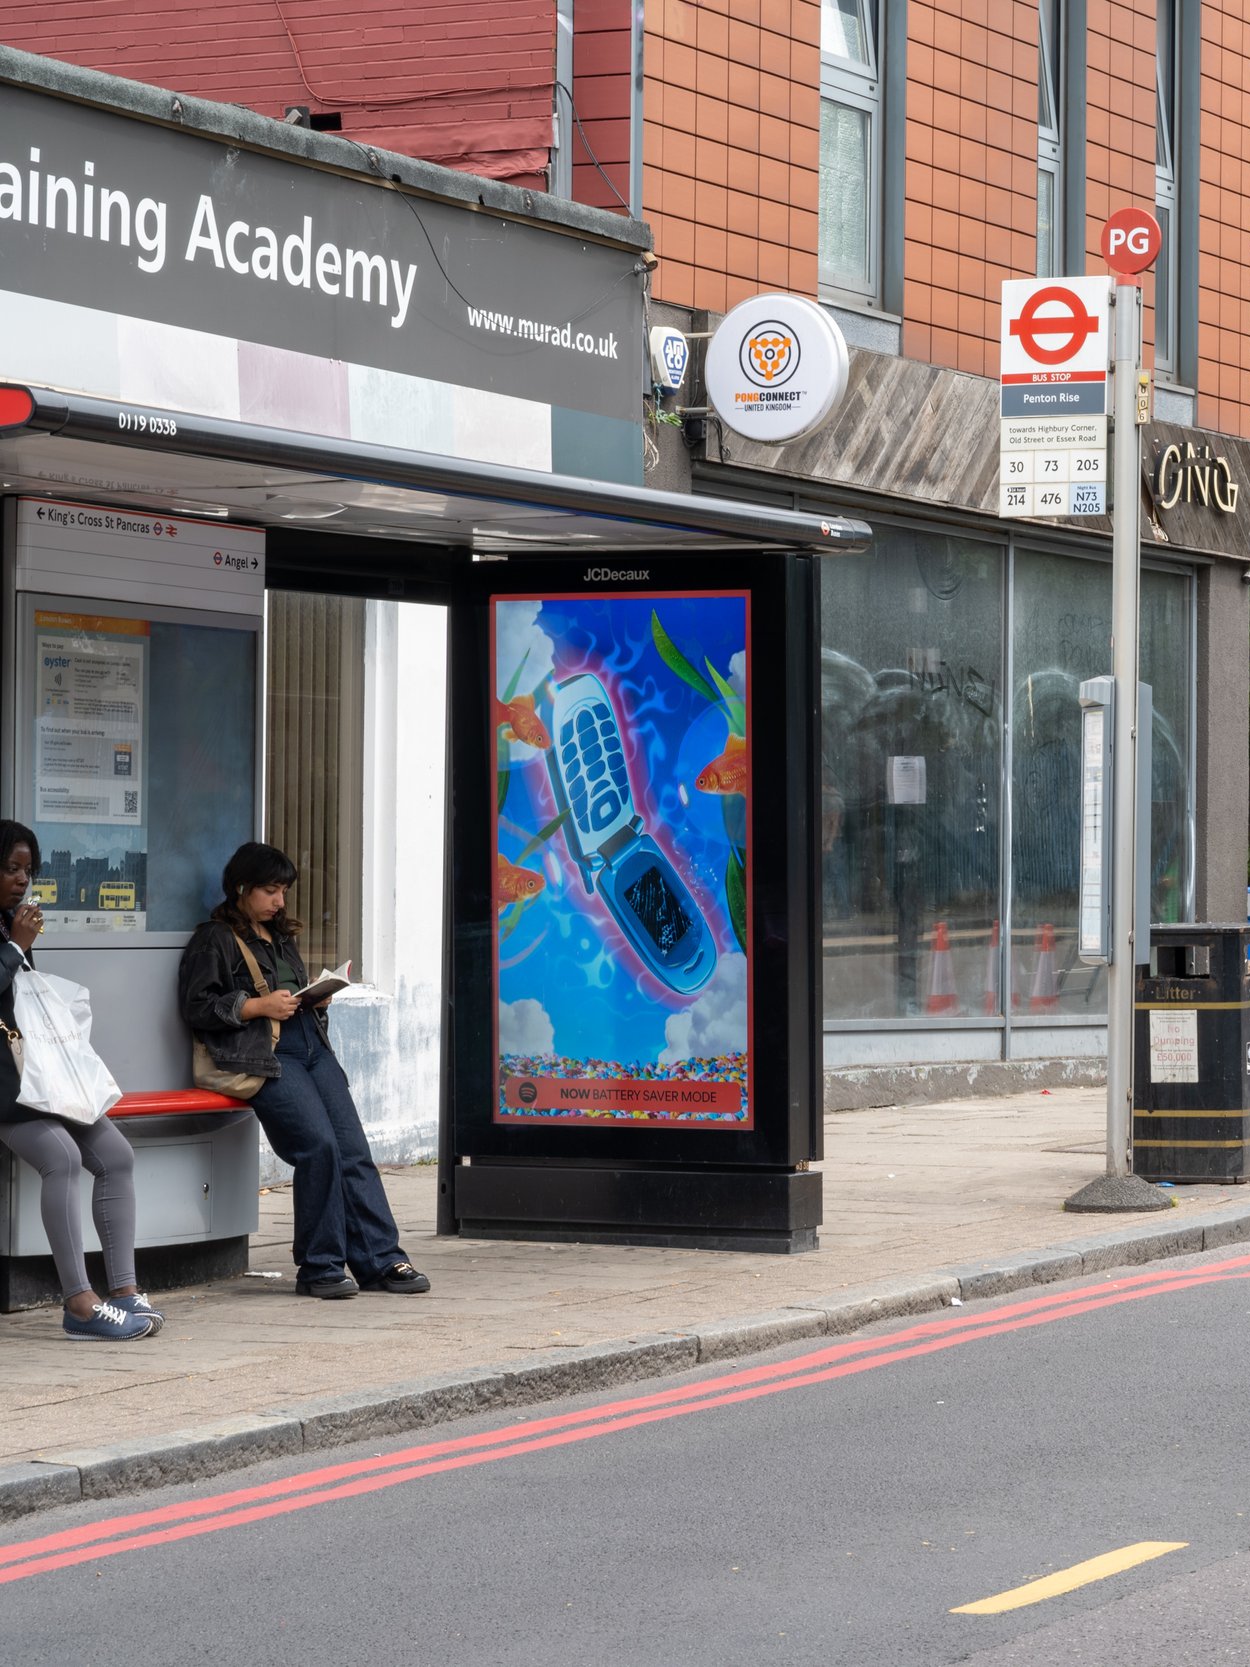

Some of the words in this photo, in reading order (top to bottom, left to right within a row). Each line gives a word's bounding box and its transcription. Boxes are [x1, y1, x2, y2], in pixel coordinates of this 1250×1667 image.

[1109, 227, 1149, 256] PG
[184, 194, 418, 329] Academy
[467, 306, 618, 360] www.murad.co.uk
[1032, 373, 1047, 382] BUS
[1051, 372, 1071, 381] STOP
[735, 391, 801, 403] PONGCONNECT
[1023, 393, 1057, 404] Penton
[1059, 392, 1080, 402] Rise
[744, 402, 764, 412] UNITED
[765, 402, 792, 411] KINGDOM
[118, 412, 146, 432] 0119
[149, 416, 177, 436] 0338
[1009, 426, 1036, 434] towards
[1038, 424, 1069, 434] Highbury
[1009, 436, 1022, 444] Old
[1023, 436, 1045, 444] Street
[1056, 435, 1076, 443] Essex
[1078, 434, 1097, 442] Road
[1009, 461, 1024, 473] 30
[1044, 460, 1059, 472] 73
[1076, 459, 1099, 471] 205
[1007, 494, 1026, 506] 214
[1040, 493, 1062, 505] 476
[1076, 491, 1097, 501] N73
[1073, 503, 1101, 513] N205
[48, 507, 75, 524] King's
[77, 511, 103, 527] Cross
[104, 515, 115, 529] St
[116, 517, 150, 534] Pancras
[224, 554, 249, 570] Angel
[583, 567, 650, 582] JCDecaux
[44, 656, 71, 669] oyster
[1156, 986, 1196, 999] Litter
[1167, 1025, 1180, 1033] No
[1153, 1036, 1195, 1047] Dumping
[1156, 1052, 1192, 1062] £50,000
[560, 1087, 590, 1100] NOW
[593, 1088, 640, 1101] BATTERY
[642, 1089, 679, 1102] SAVER
[681, 1090, 717, 1103] MODE
